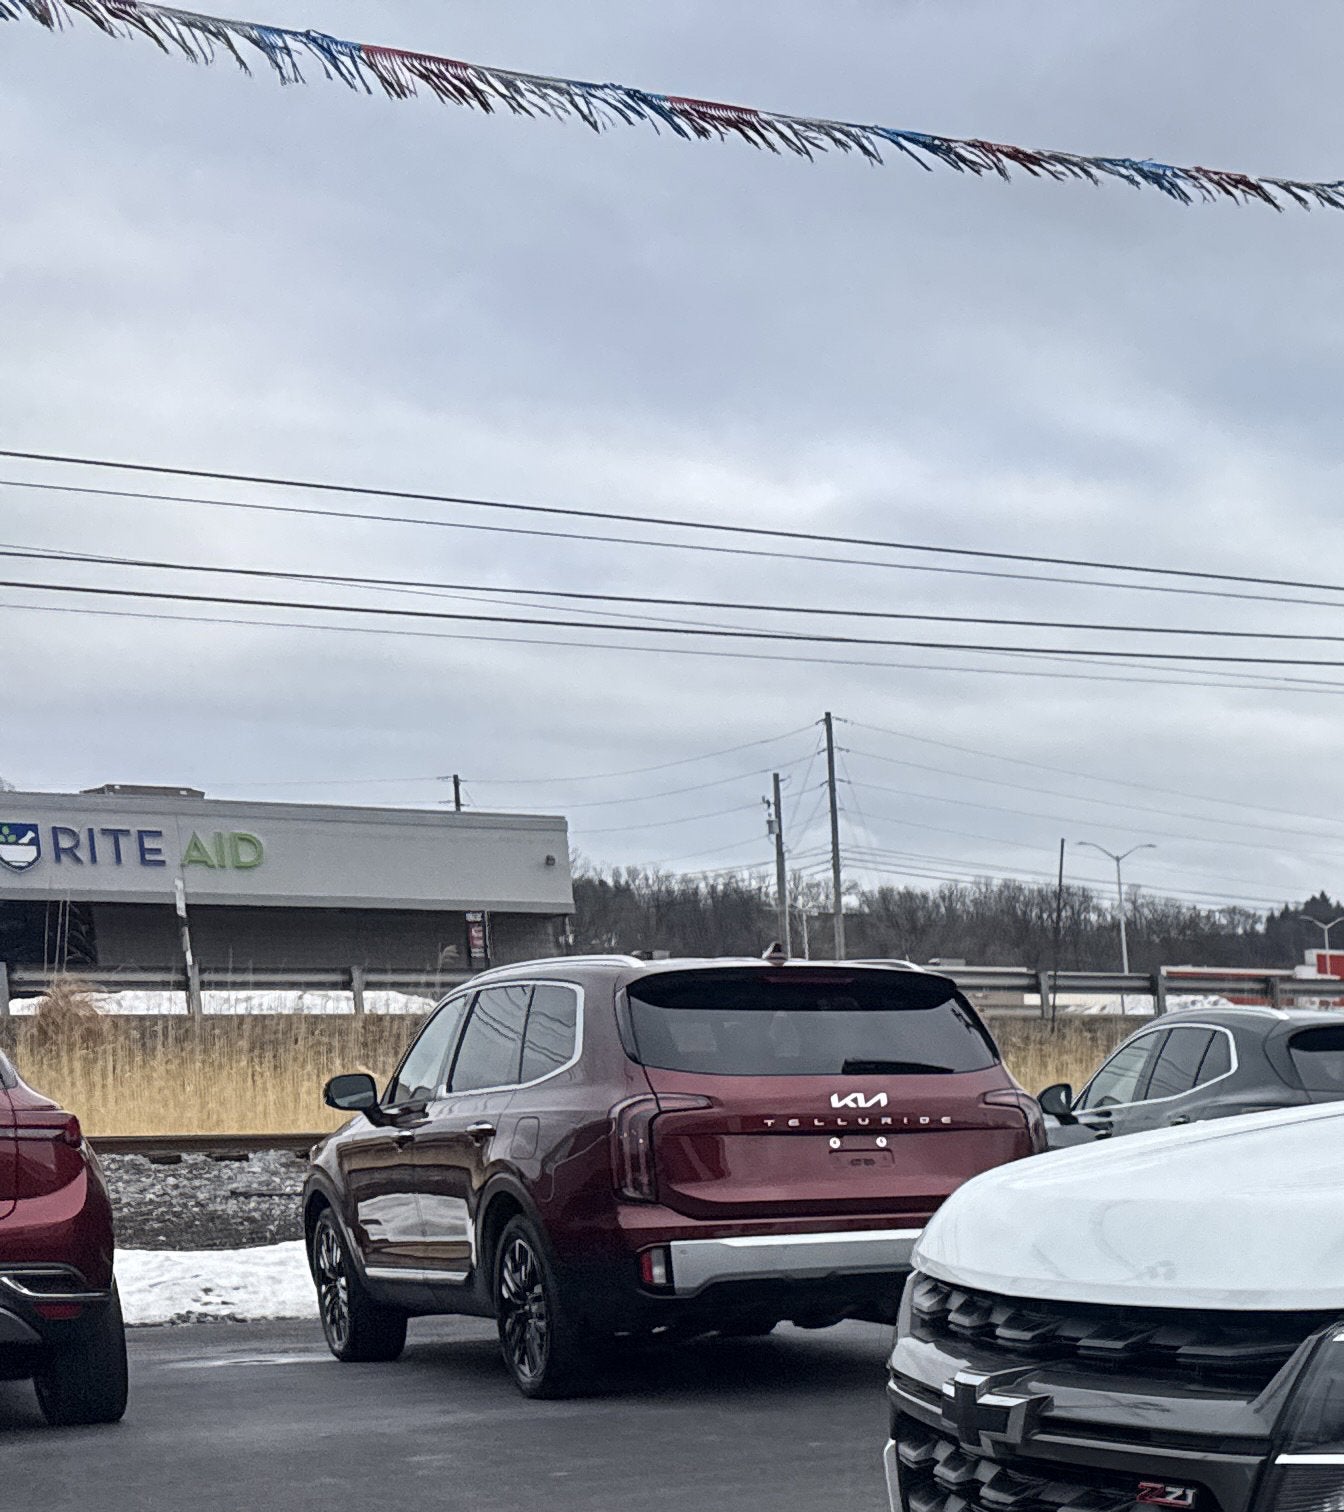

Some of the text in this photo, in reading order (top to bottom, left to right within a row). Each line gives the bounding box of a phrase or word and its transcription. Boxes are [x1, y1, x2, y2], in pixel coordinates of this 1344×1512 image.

[52, 825, 264, 870] RITE AID
[763, 1116, 953, 1128] TELLURIDE
[1135, 1481, 1197, 1510] Z71
